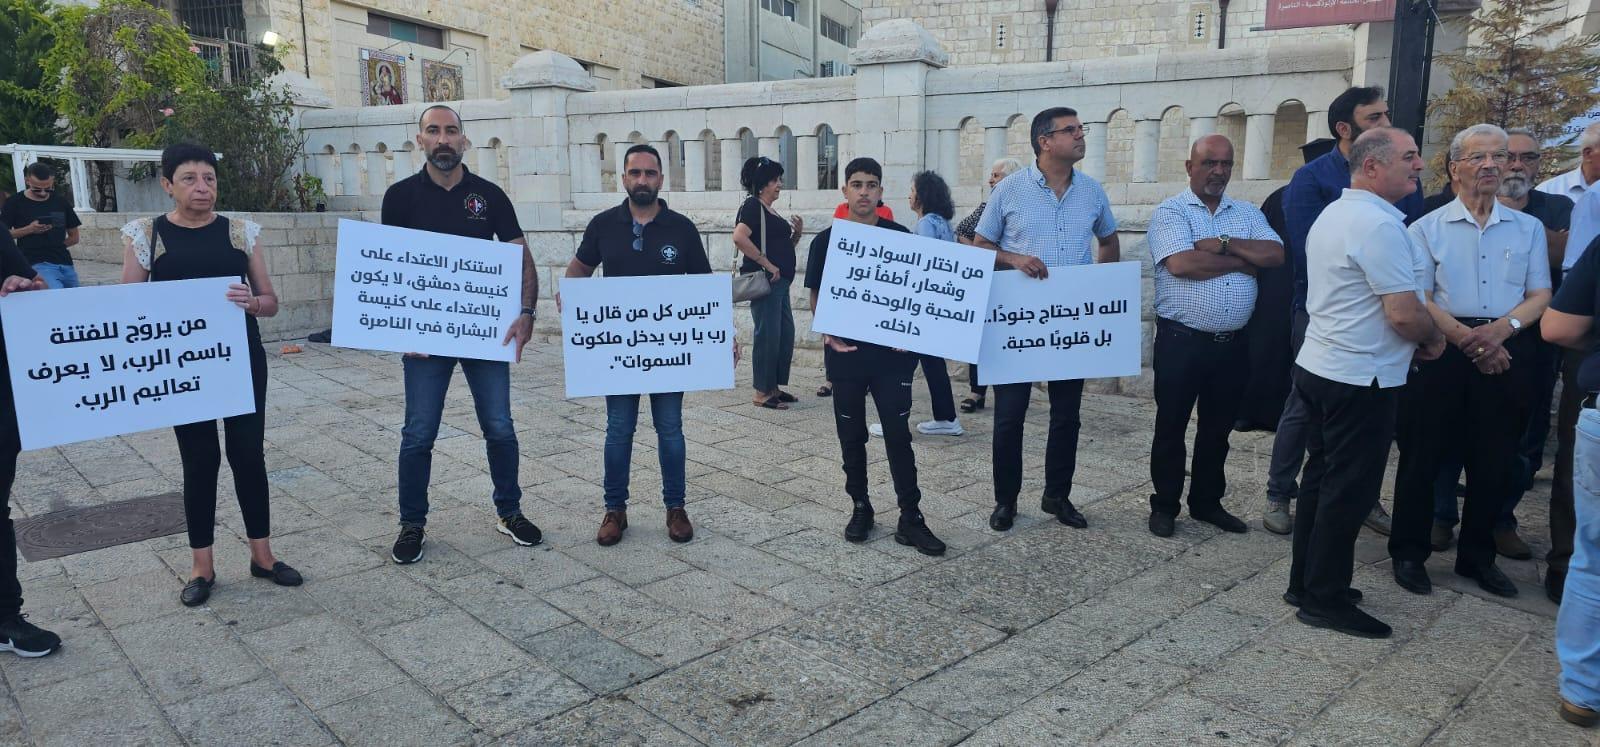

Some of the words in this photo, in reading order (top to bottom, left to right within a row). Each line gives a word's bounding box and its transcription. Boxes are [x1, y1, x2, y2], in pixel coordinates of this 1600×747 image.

[361, 248, 393, 261] على
[838, 238, 866, 258] راية
[869, 246, 921, 266] السواد
[397, 252, 447, 268] الاعتداء
[451, 258, 502, 275] استنكار
[923, 257, 959, 273] اختار
[351, 270, 388, 286] يكون
[393, 272, 402, 284] لا
[846, 267, 871, 281] نور
[875, 264, 910, 286] أطفأ
[962, 267, 983, 279] من
[407, 275, 460, 291] دمشق،
[464, 281, 508, 299] كنيسة
[912, 278, 965, 301] وشعار،
[358, 291, 407, 309] كنيسة
[831, 286, 857, 300] في
[411, 298, 442, 311] على
[446, 301, 500, 318] بالاعتداء
[862, 289, 921, 316] والوحدة
[1084, 302, 1094, 315] لا
[1099, 300, 1127, 314] الله
[577, 307, 588, 324] يا
[593, 306, 621, 323] قال
[626, 309, 648, 322] من
[653, 304, 672, 321] كل
[925, 302, 975, 323] المحبة
[1039, 305, 1079, 324] يحتاج
[126, 316, 172, 343] يروّج
[178, 319, 206, 336] من
[360, 314, 411, 330] الناصرة
[416, 321, 442, 334] في
[875, 318, 920, 336] داخله.
[50, 322, 119, 344] للفتنة
[446, 323, 497, 340] البشارة
[571, 331, 622, 349] ملكوت
[627, 330, 664, 347] يدخل
[669, 332, 687, 345] رب
[692, 328, 703, 344] يا
[708, 330, 725, 343] رب
[1050, 330, 1090, 350] قلوبًا
[1094, 330, 1111, 347] بل
[1002, 336, 1045, 352] محبة.
[100, 354, 115, 372] لا
[123, 348, 171, 373] الرب،
[178, 342, 231, 368] باسم
[28, 362, 90, 384] يعرف
[75, 385, 126, 411] الرب.
[133, 376, 200, 405] تعاليم
